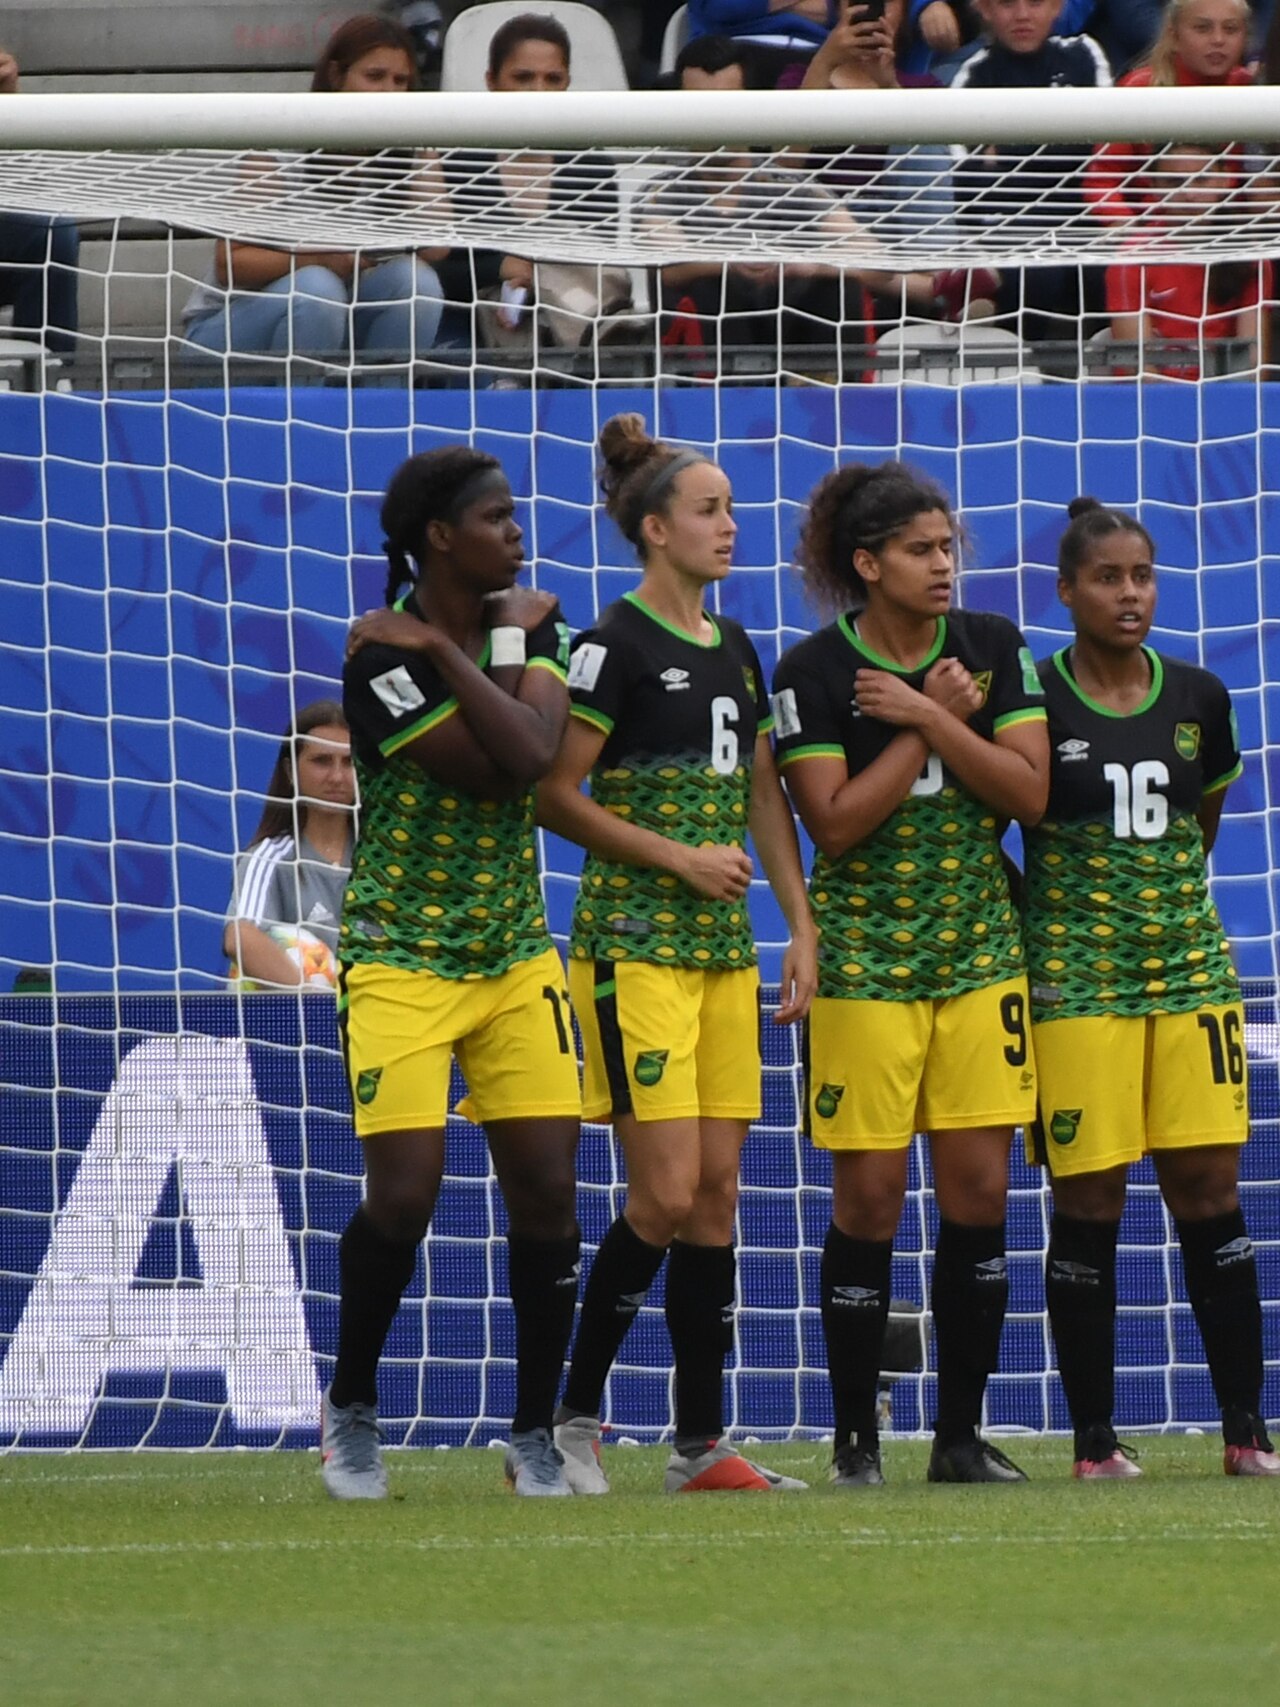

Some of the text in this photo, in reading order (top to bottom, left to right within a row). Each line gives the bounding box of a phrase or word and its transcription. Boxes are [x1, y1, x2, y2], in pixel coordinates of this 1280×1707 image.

[711, 696, 740, 774] 6
[1103, 760, 1169, 838] 16
[1000, 992, 1027, 1067] 9
[1197, 1010, 1244, 1085] 16
